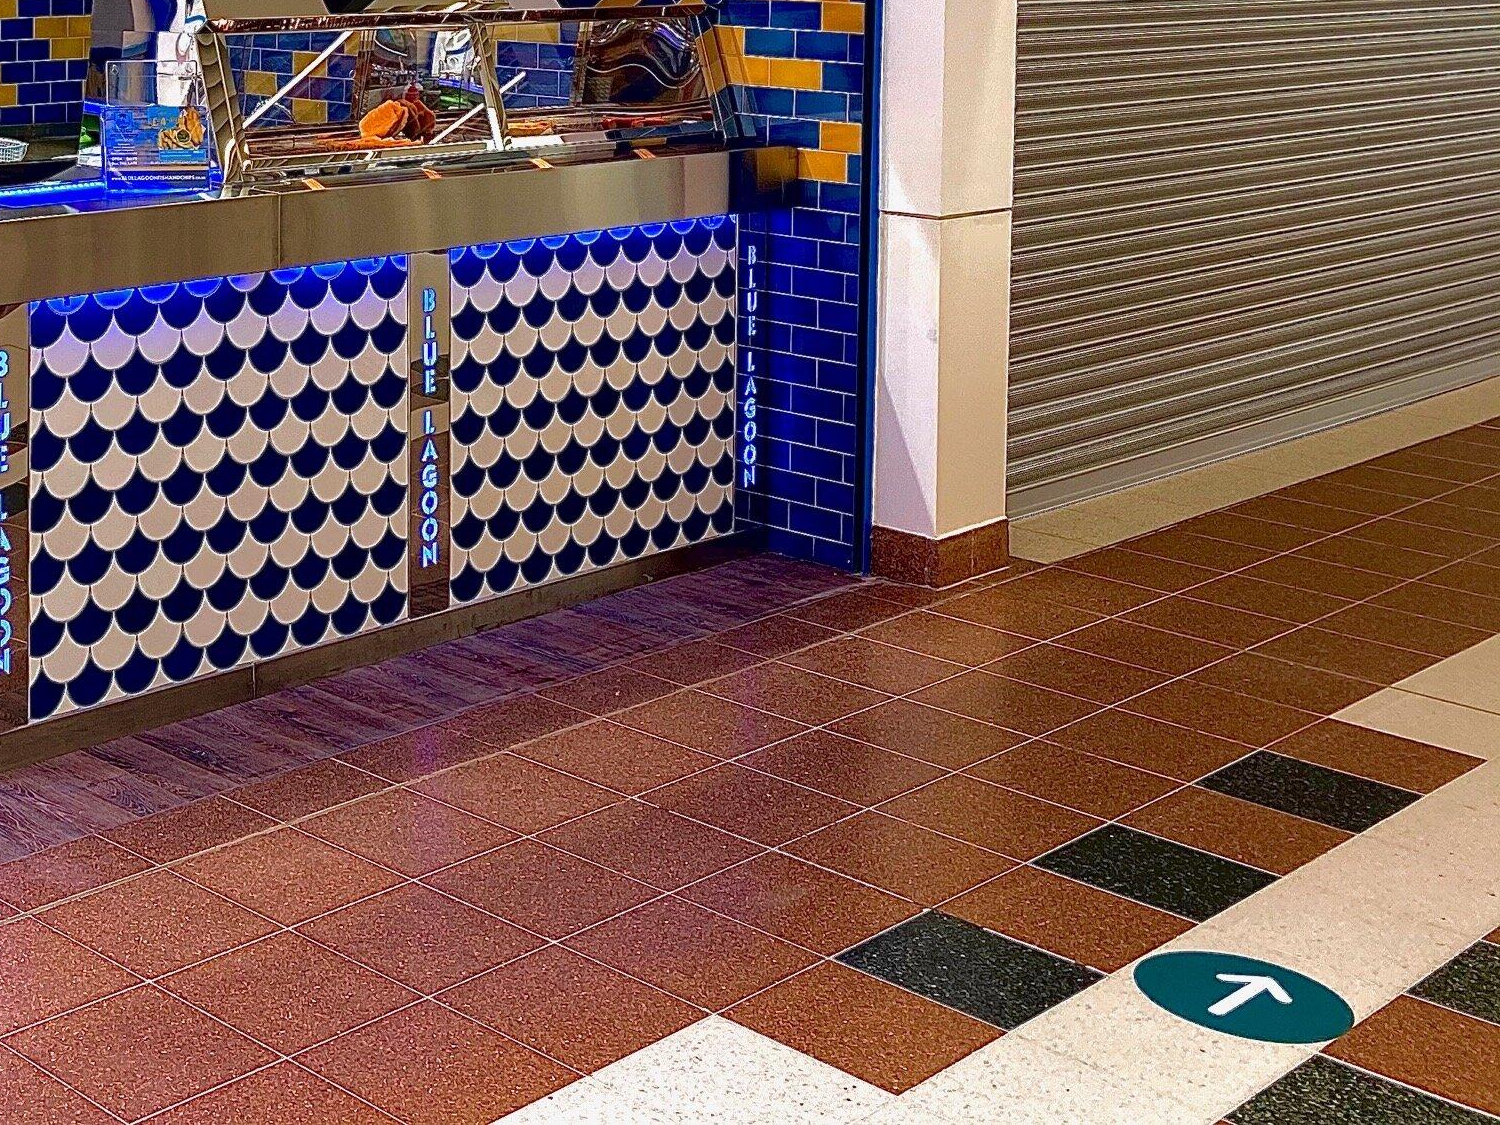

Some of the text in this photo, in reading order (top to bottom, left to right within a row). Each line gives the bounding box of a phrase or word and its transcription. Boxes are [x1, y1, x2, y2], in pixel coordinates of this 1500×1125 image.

[421, 288, 439, 568] BLUE LAGOON
[743, 245, 758, 489] BLUE LAGOON
